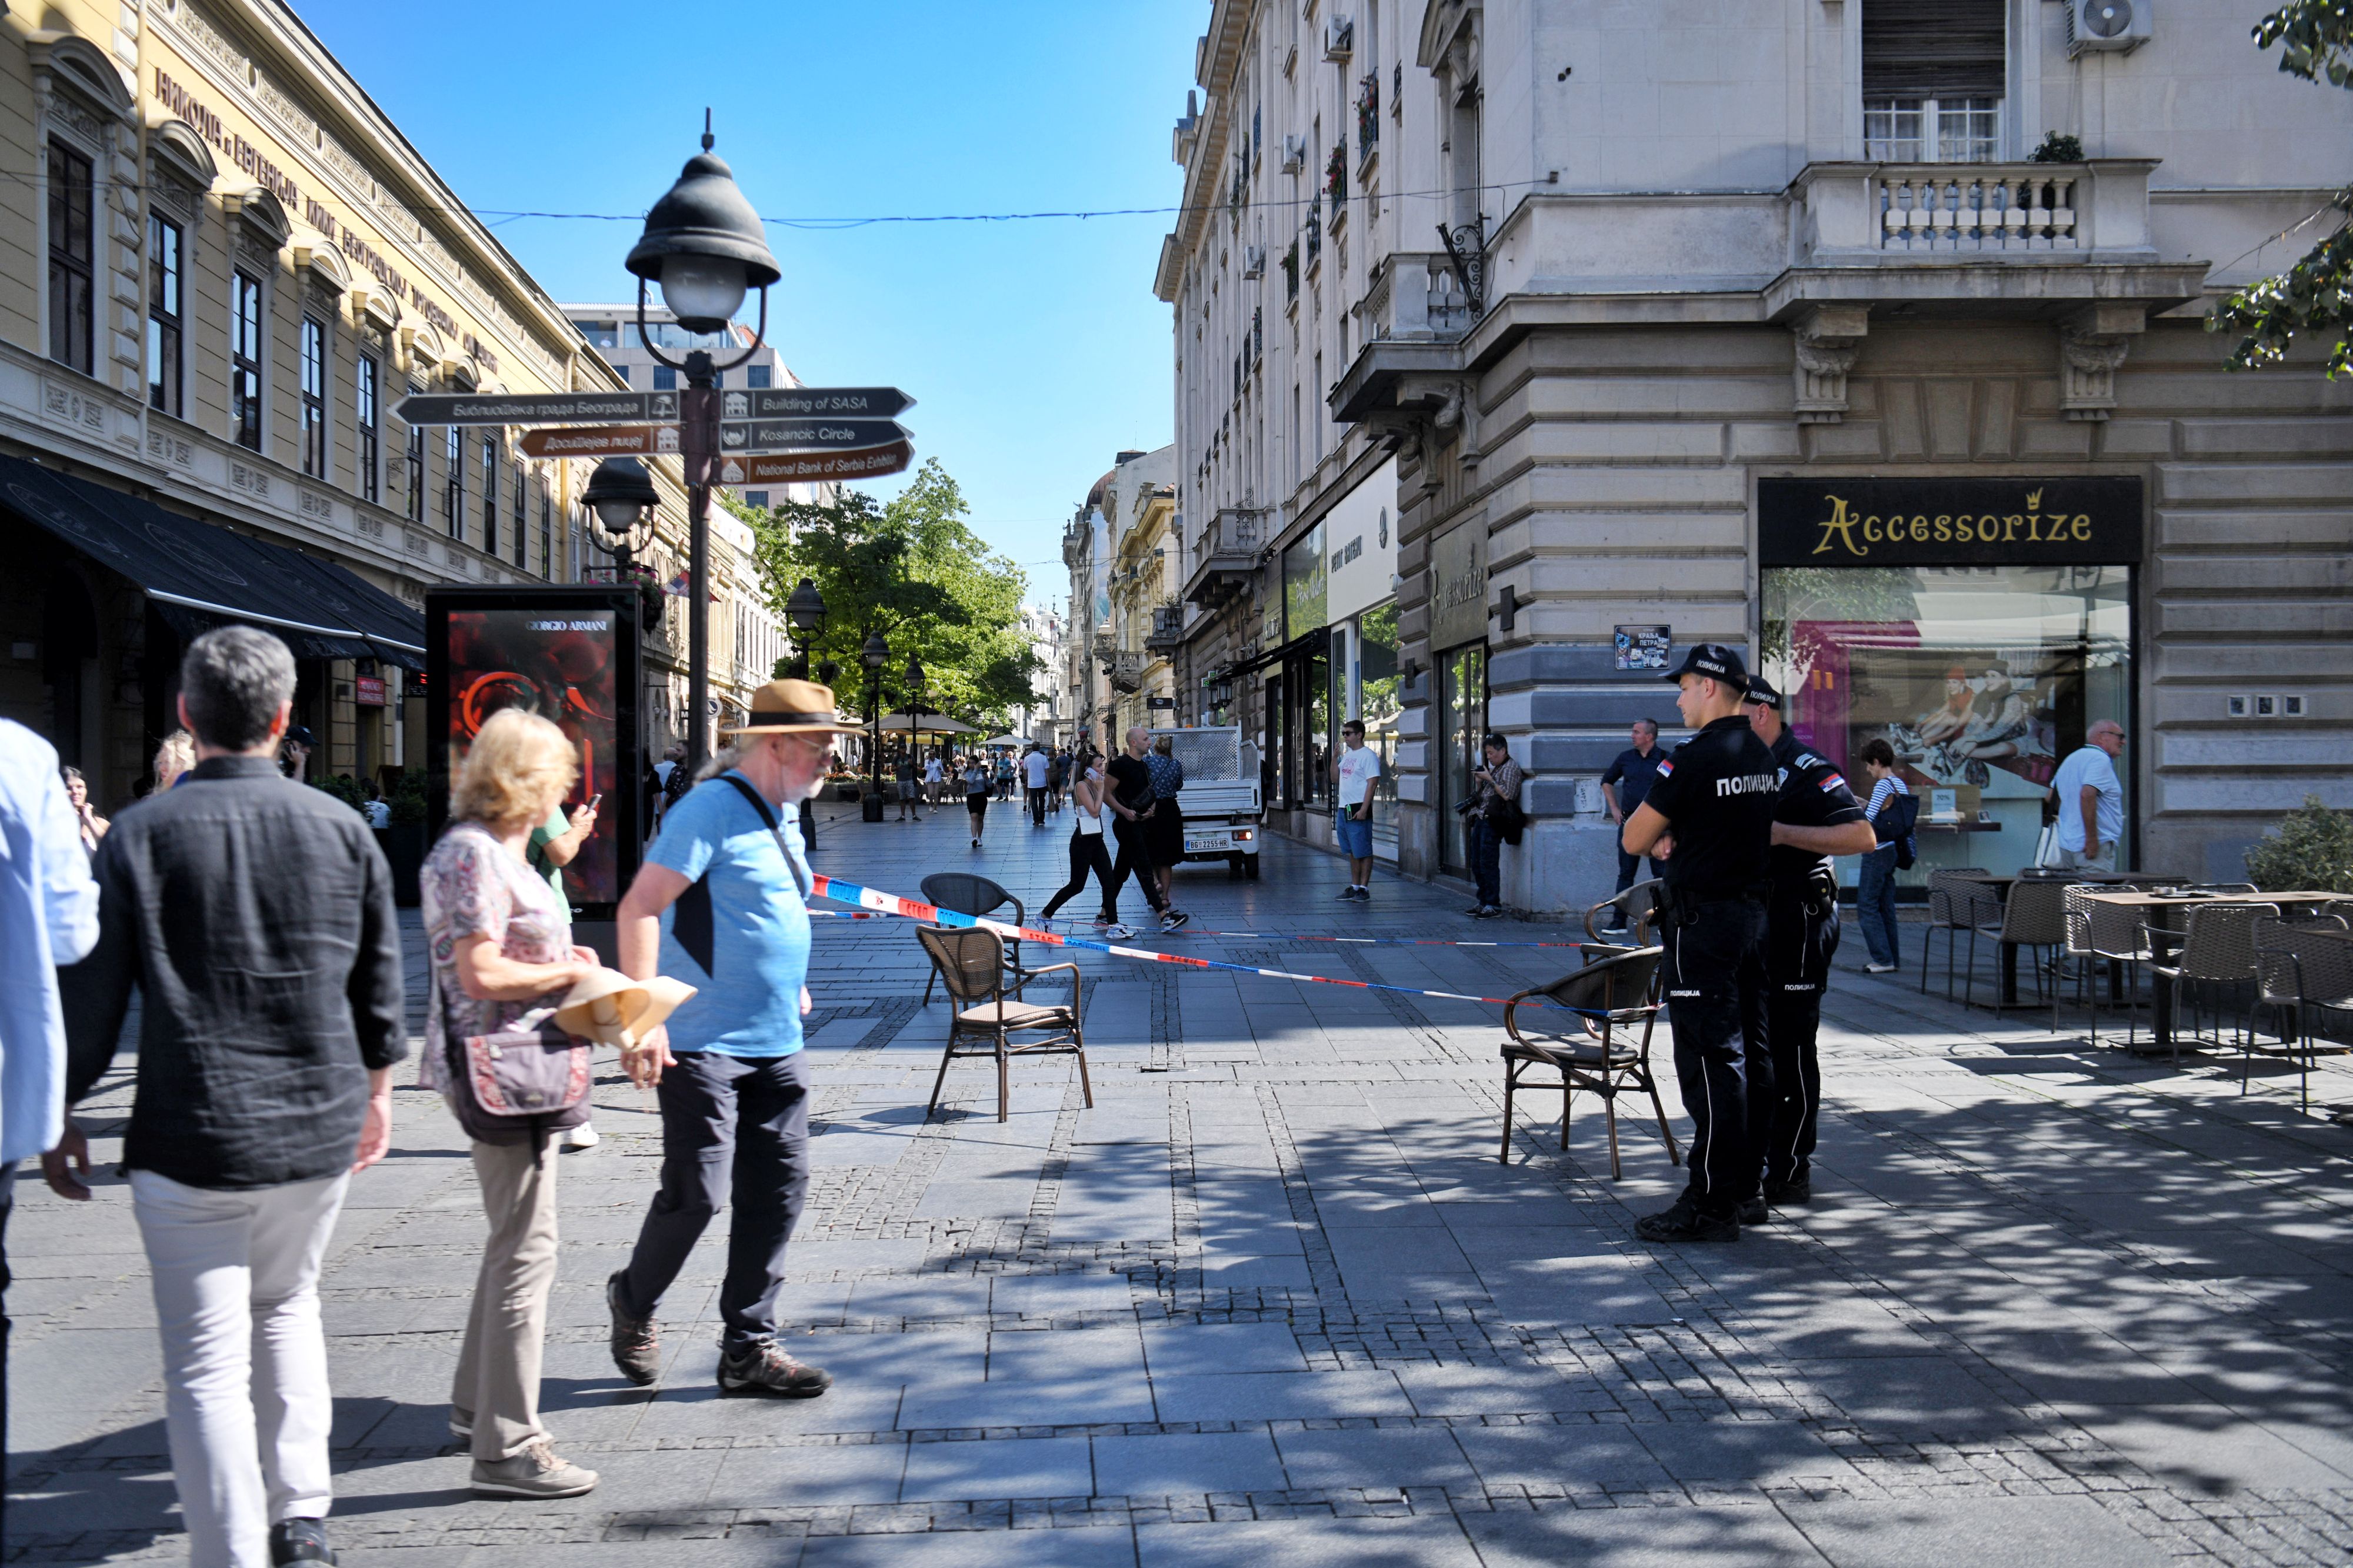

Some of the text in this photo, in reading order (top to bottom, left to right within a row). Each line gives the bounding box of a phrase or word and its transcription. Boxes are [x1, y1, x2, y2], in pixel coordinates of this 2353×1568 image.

[155, 66, 222, 150] НИКОЛА
[235, 134, 298, 211] ЕВГЕНИЈА
[576, 401, 639, 415] Београда
[762, 397, 868, 412] Building of SASA
[819, 428, 855, 441] Circle
[755, 463, 796, 476] National
[797, 462, 822, 474] Bank
[825, 461, 835, 472] of
[836, 458, 865, 472] Serbia
[1812, 494, 2092, 556] Accessorize
[525, 620, 607, 630] GIORGIO ARMANI
[1696, 659, 1725, 674] ПОЛИЦИЈА
[1750, 690, 1775, 703] ПОЛИЦИЈА
[1717, 775, 1781, 796] ПОЛИЦИЈ
